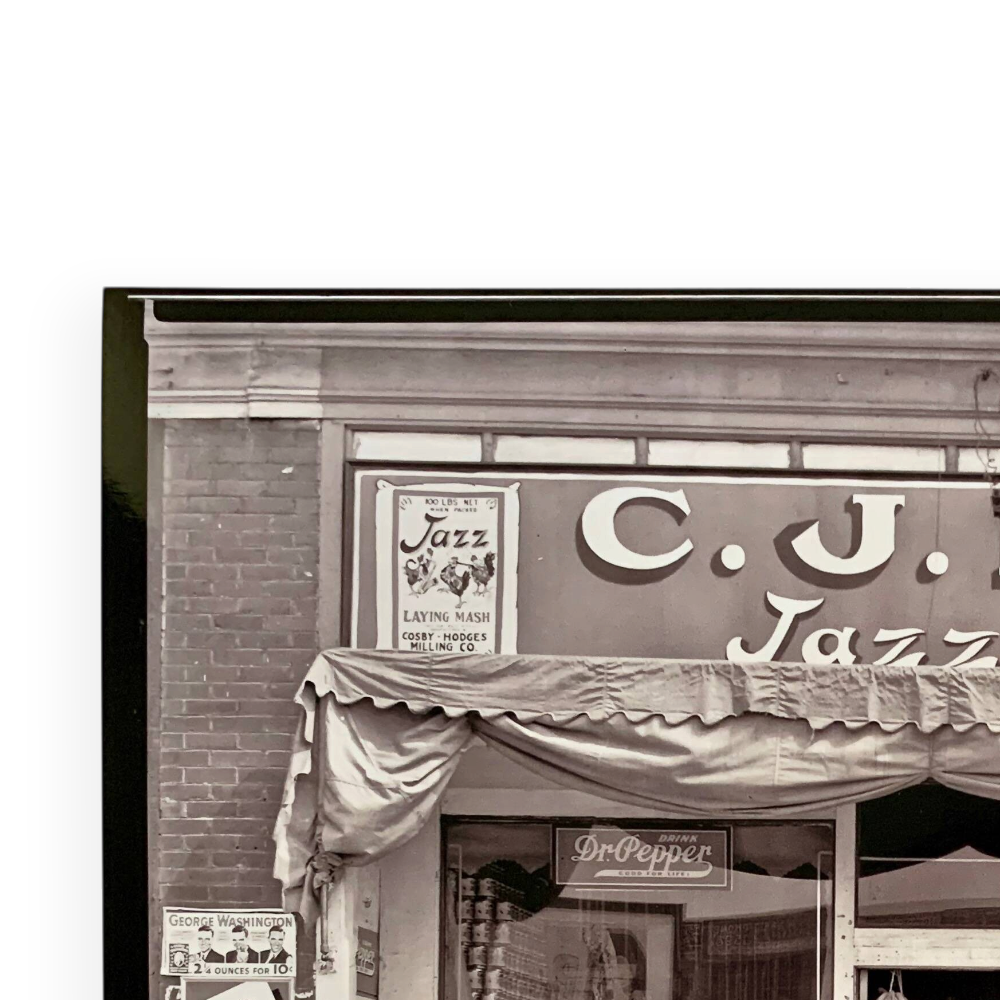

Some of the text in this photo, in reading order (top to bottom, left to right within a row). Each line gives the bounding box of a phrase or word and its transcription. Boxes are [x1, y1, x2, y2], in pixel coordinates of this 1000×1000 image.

[400, 513, 489, 553] Jazz
[404, 610, 490, 623] LAYING MASH
[726, 590, 1000, 667] Jazz
[402, 631, 435, 641] COSBY
[443, 632, 487, 641] HODGES
[410, 642, 453, 652] MILLING
[659, 834, 699, 843] DRINK
[169, 914, 292, 927] GEORGE WASHINGTON
